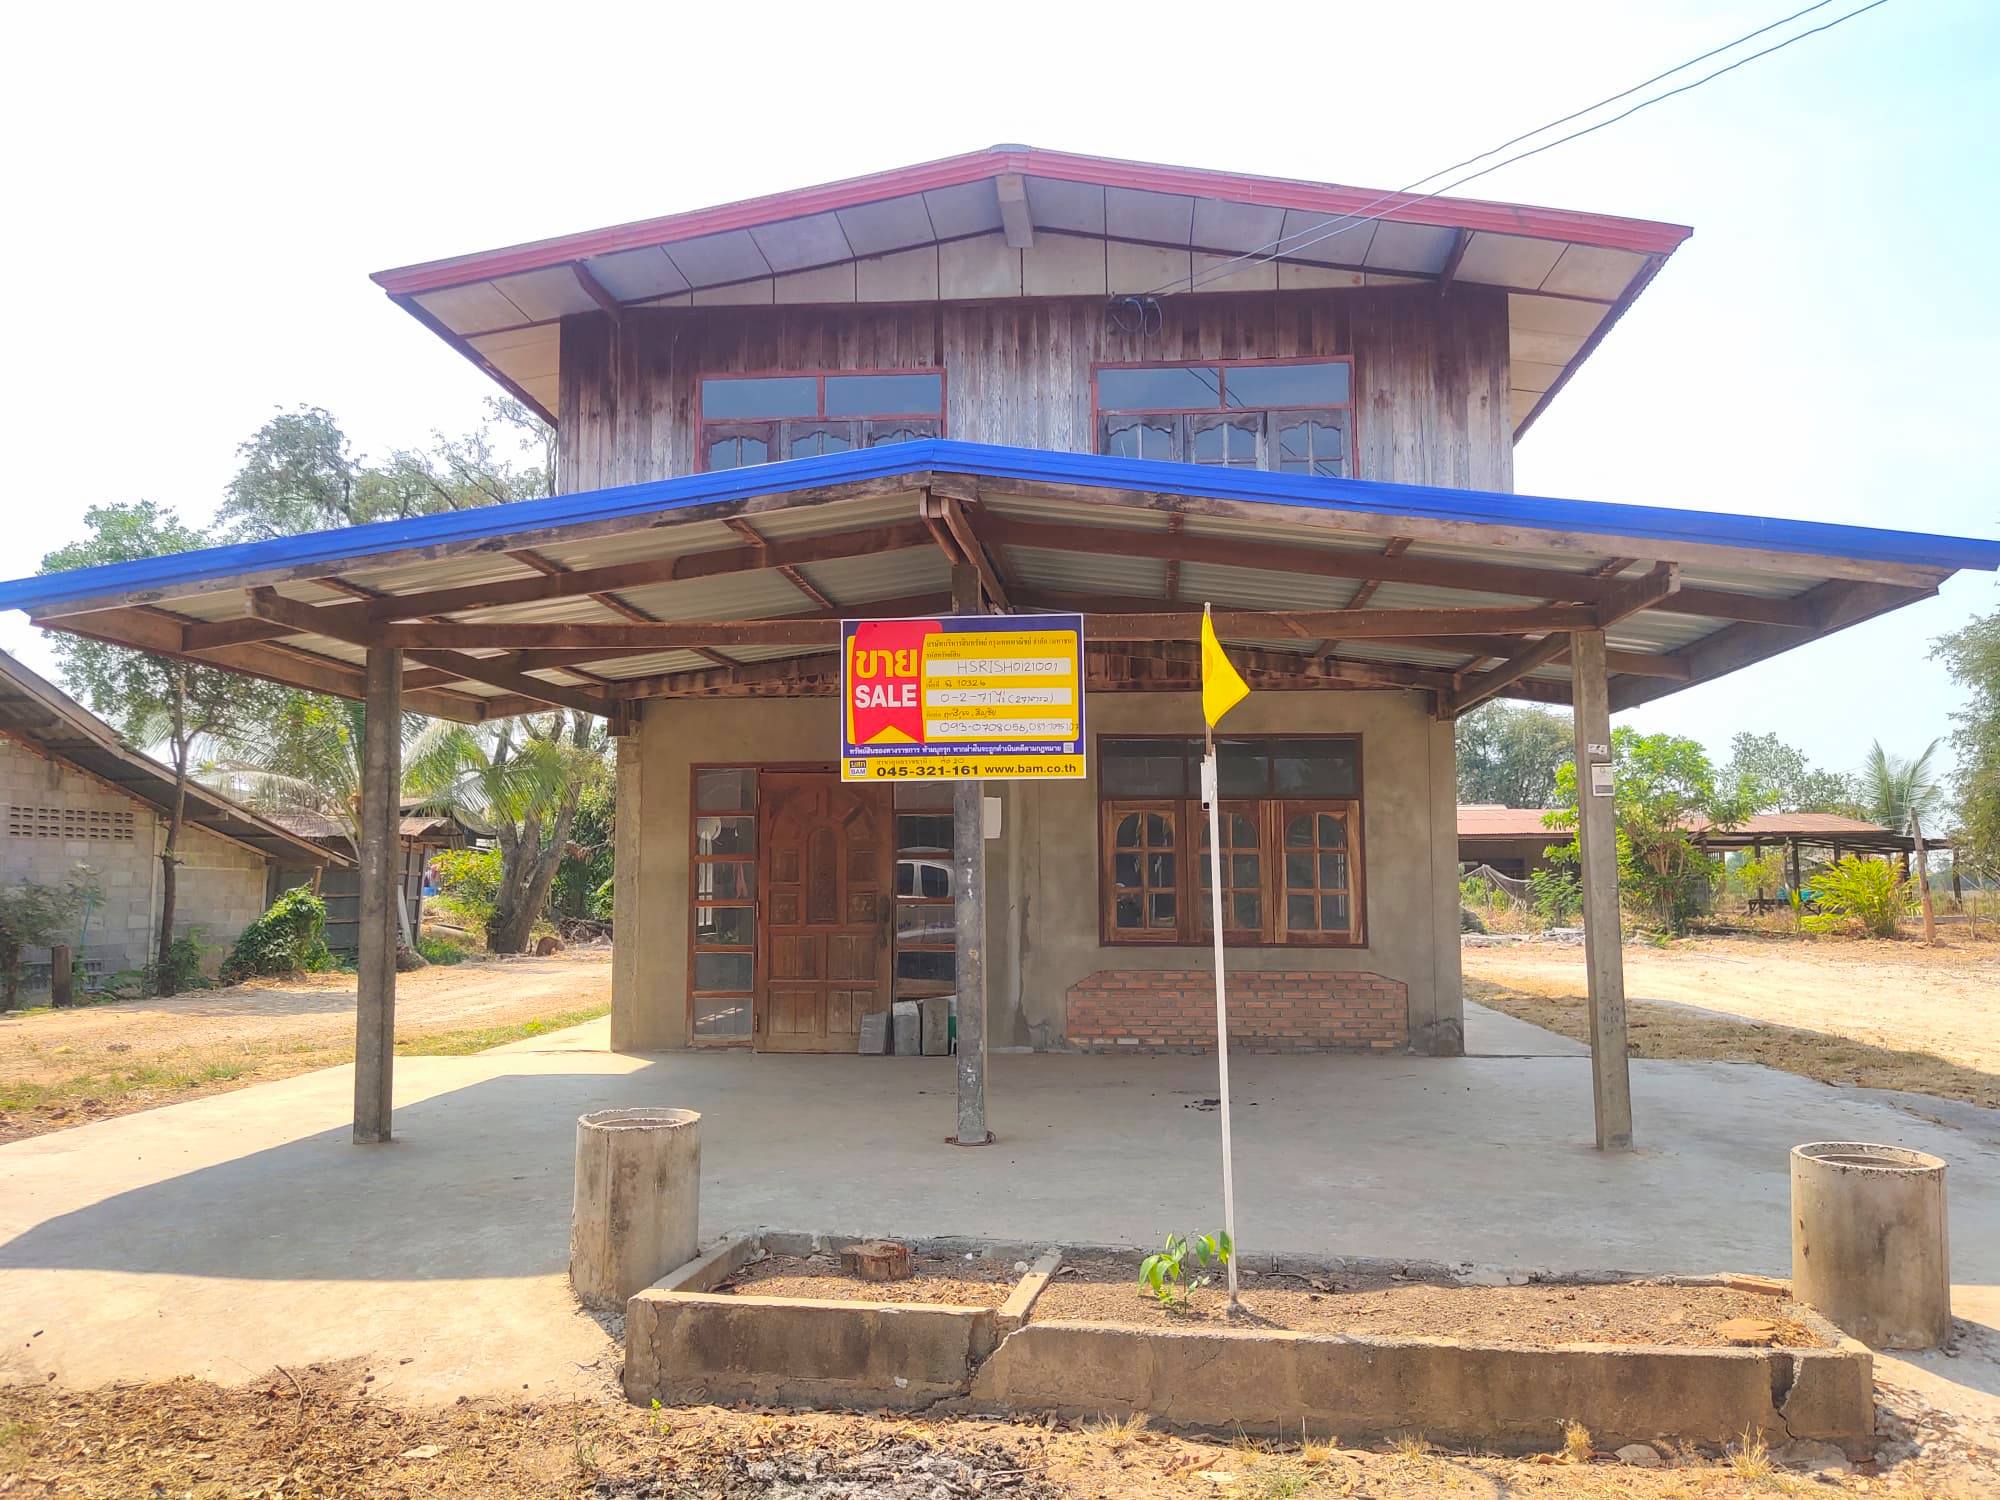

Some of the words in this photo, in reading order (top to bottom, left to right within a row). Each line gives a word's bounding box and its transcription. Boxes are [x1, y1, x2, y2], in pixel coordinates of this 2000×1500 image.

[855, 648, 917, 679] ขาย
[855, 683, 917, 708] SALE
[876, 765, 978, 777] 045-321-161
[984, 763, 1077, 775] www.bam.co.th
